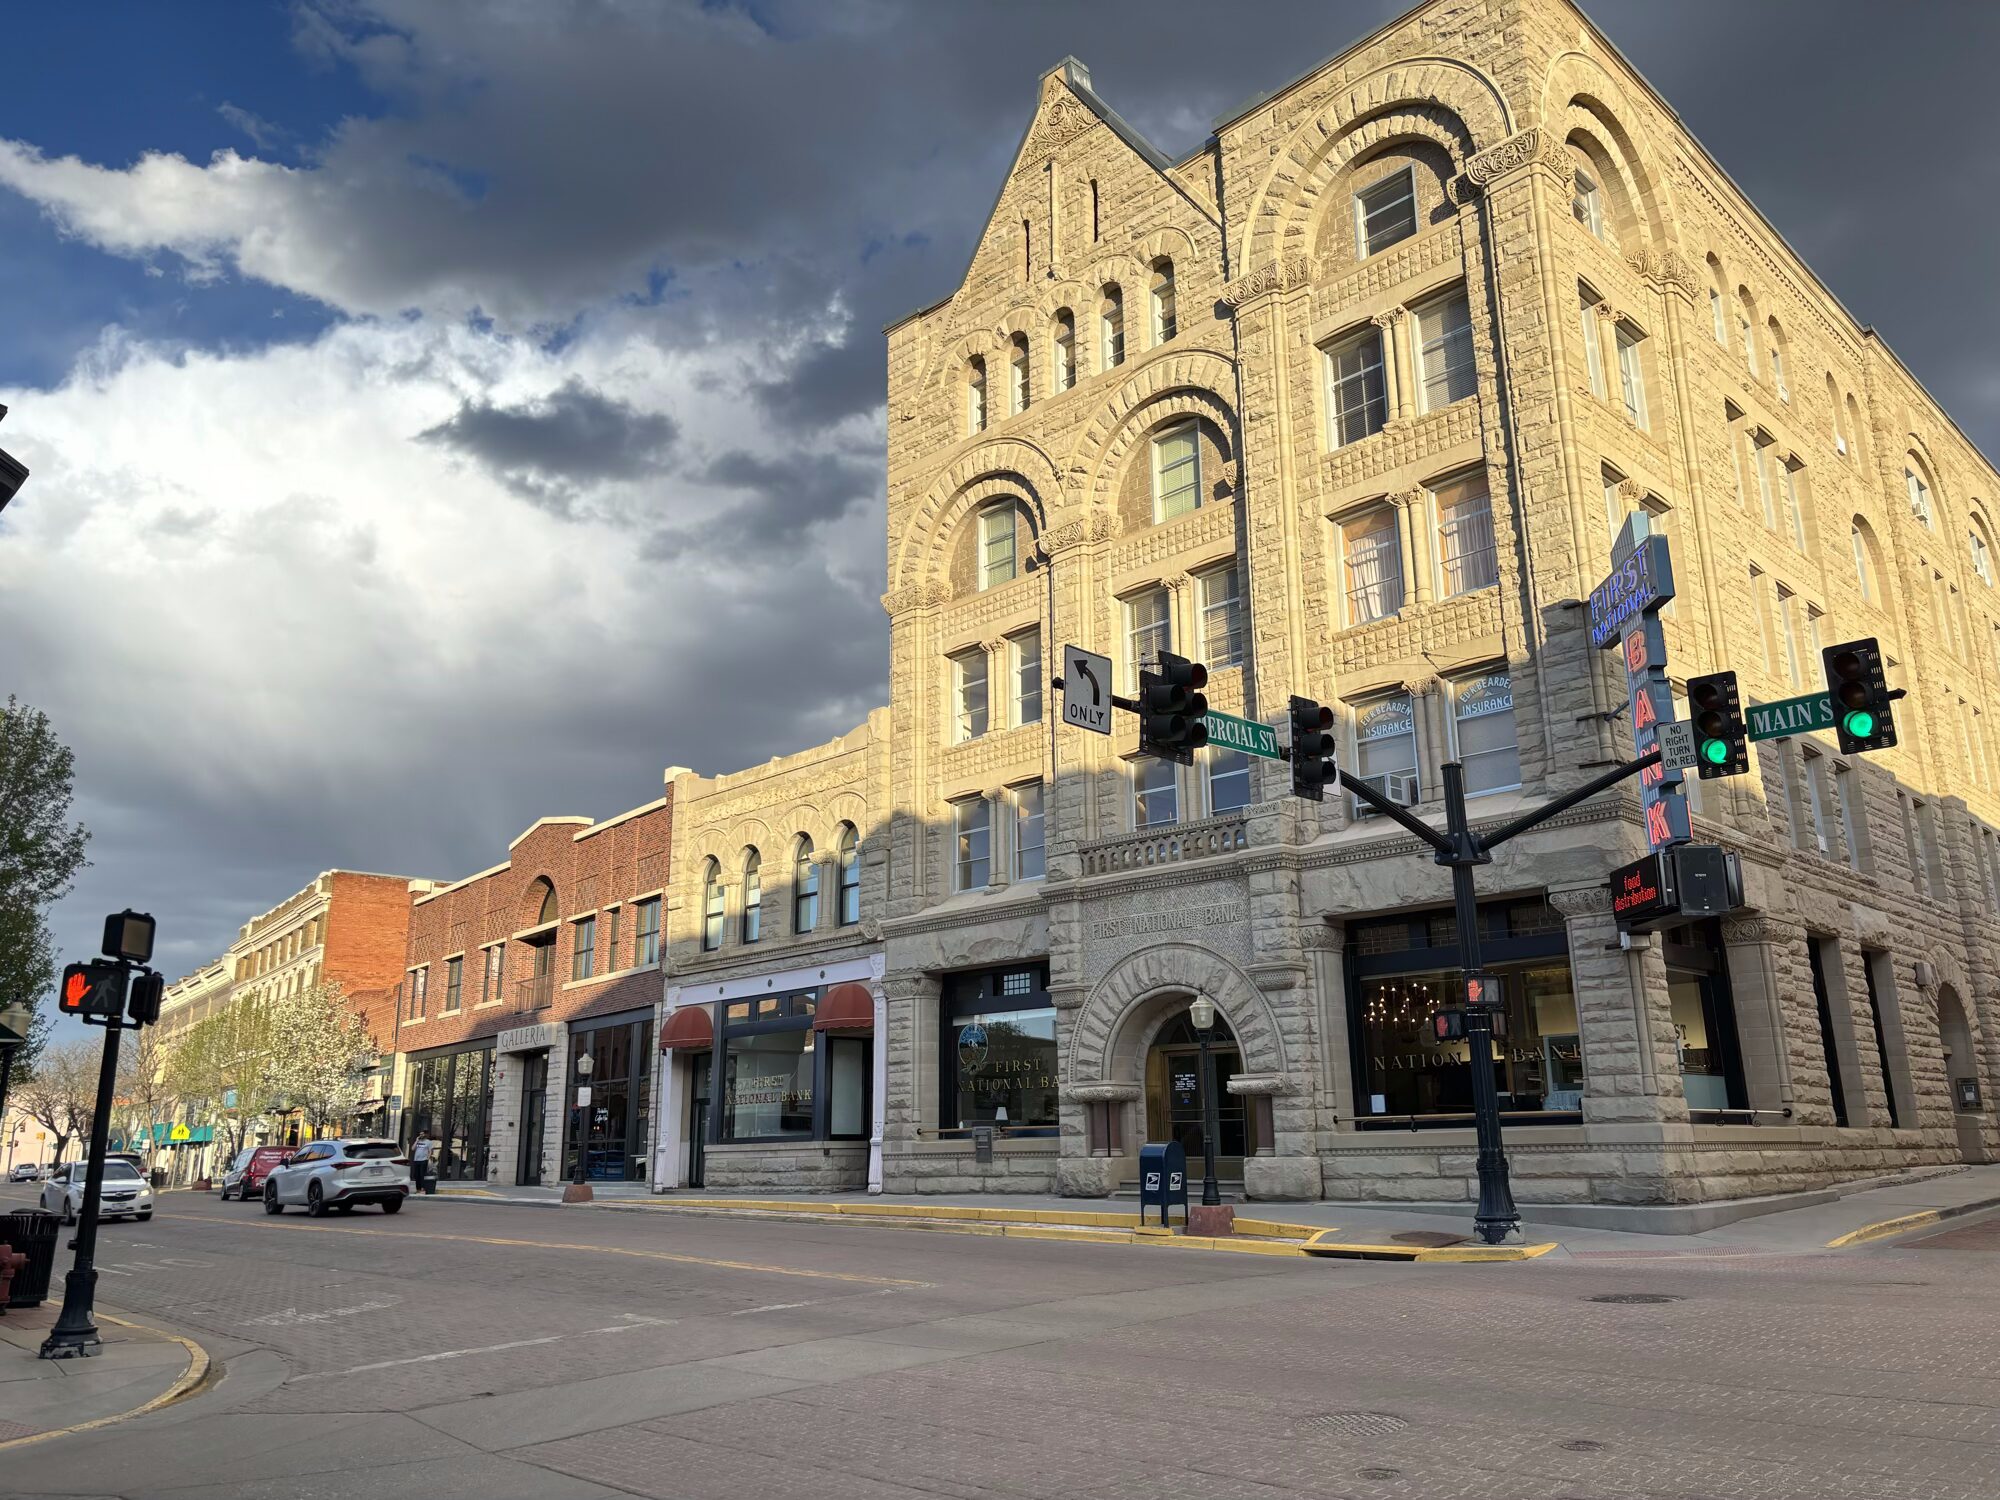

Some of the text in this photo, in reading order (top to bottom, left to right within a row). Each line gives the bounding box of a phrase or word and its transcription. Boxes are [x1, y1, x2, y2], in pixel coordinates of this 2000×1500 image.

[1590, 543, 1649, 621] FIRST
[1592, 582, 1654, 645] NATIONAL
[1476, 676, 1512, 690] BEARDE
[1070, 703, 1105, 726] ONLY
[1375, 702, 1411, 716] BEARDEN
[1751, 701, 1813, 735] MAIN
[1362, 718, 1412, 738] INSURANCE
[1669, 725, 1682, 736] NO
[1259, 729, 1276, 753] ST
[1626, 630, 1671, 846] BANK
[1665, 734, 1689, 747] RIGHT
[1668, 744, 1691, 757] TURN
[1665, 754, 1697, 768] ON RED
[1092, 902, 1239, 941] FIRST NATIONAL BANK
[501, 1025, 546, 1049] GALLERIA
[995, 1058, 1041, 1073] FIRST
[752, 1075, 784, 1089] FIRST
[725, 1089, 812, 1106] NATIONAL BANK
